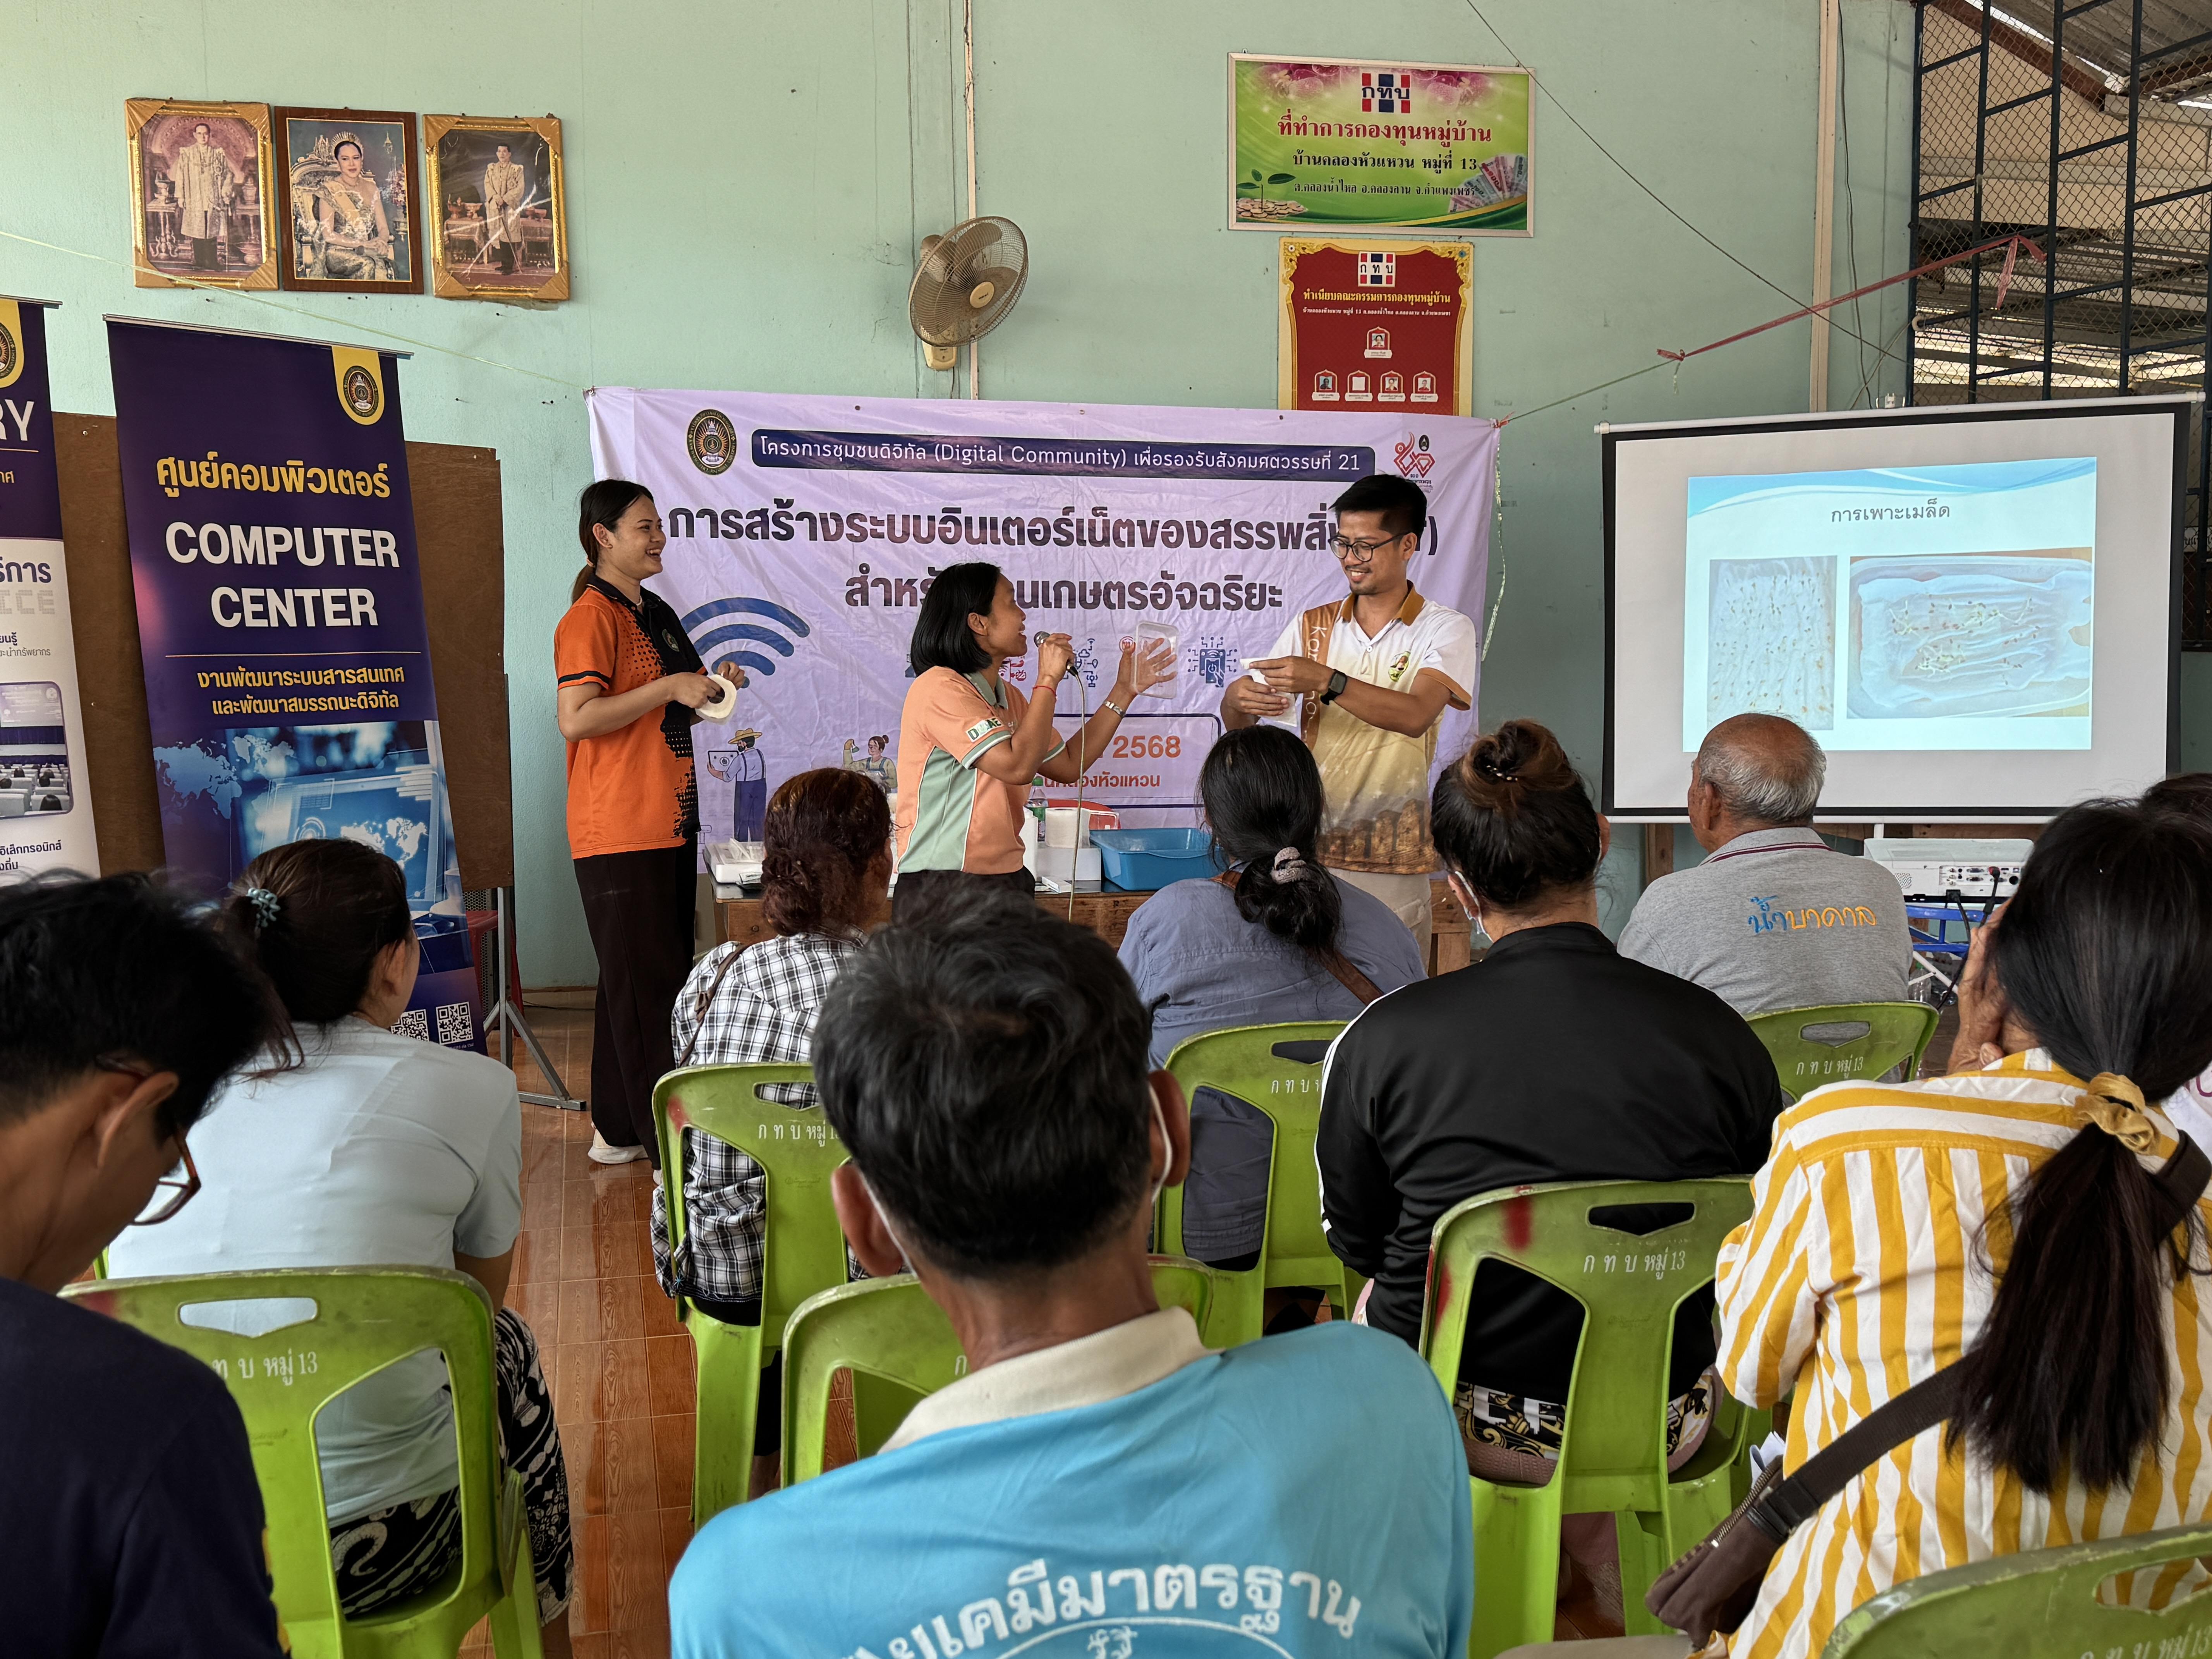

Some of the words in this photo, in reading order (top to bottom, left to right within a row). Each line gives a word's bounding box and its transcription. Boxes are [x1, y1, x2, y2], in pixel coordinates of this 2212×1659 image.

[1362, 84, 1410, 100] กทบ
[1278, 108, 1492, 148] ที่ทำการกองทุนหมู่บ้าน
[1293, 149, 1415, 168] บ้านคลองหัวแหวน
[1422, 150, 1452, 173] หมู่ที่
[1460, 158, 1477, 170] 13
[1303, 289, 1451, 306] ทำเนียบคณะกรรมการกองทุนหมู่บ้าน
[761, 436, 926, 462] โครงการชุมชนดิจิทัล
[934, 443, 1003, 465] (Digital
[1012, 446, 1126, 469] Community)
[1135, 448, 1332, 470] เพื่อรองรับสังคมศตวรรษที่
[1338, 454, 1360, 471] 21
[156, 451, 390, 498] ศูนย์คอมพิวเตอร์
[1831, 498, 1950, 522] การเพาะเมล็ด
[165, 522, 400, 568] COMPUTER
[211, 586, 379, 627] CENTER
[198, 665, 405, 689] งานพัฒนาระบบสารสนเทศ
[212, 690, 399, 715] และพัฒนาสมรรถนะดิจิทัล
[1112, 735, 1181, 758] 2568
[1748, 895, 1877, 934] น้ำบาดาล
[1837, 1054, 1853, 1079] หมู่
[1855, 1056, 1863, 1071] 13
[806, 1120, 826, 1147] หมู่
[1644, 1247, 1669, 1280] หมู่
[1670, 1250, 1686, 1270] 13
[263, 1348, 293, 1386] หมู่
[298, 1351, 318, 1374] 13
[841, 1558, 1362, 1659] ยเคมีมาตรฐาน
